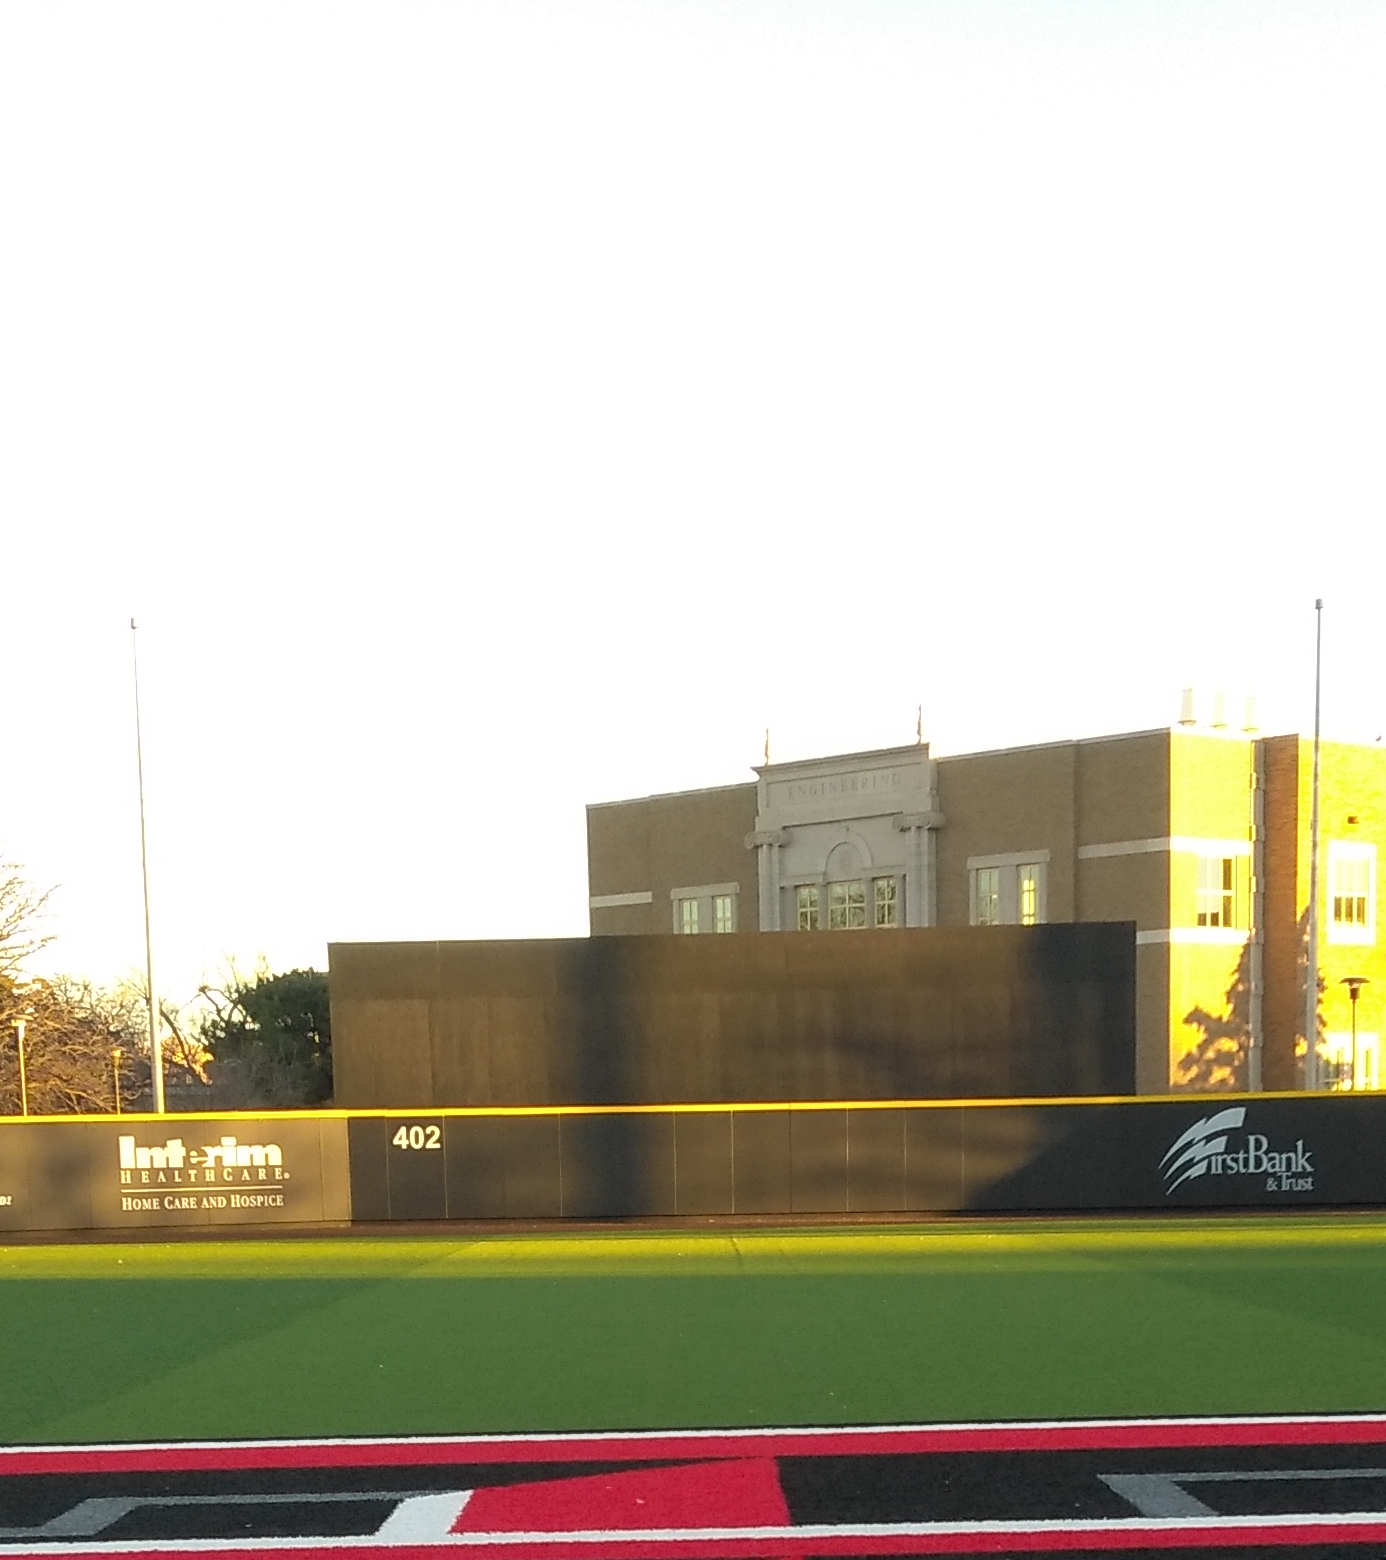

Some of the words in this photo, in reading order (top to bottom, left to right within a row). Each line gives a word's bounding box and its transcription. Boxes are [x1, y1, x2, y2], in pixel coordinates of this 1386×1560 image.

[787, 772, 901, 799] ENGINEERING
[392, 1125, 441, 1149] 402
[119, 1136, 282, 1169] Interim
[120, 1168, 283, 1184] HEALTHCARE
[1266, 1177, 1277, 1191] &
[1277, 1172, 1314, 1191] Trust
[122, 1196, 160, 1211] HOME
[164, 1195, 197, 1210] CARE
[201, 1195, 226, 1209] AND
[230, 1194, 284, 1208] HOSPICE
